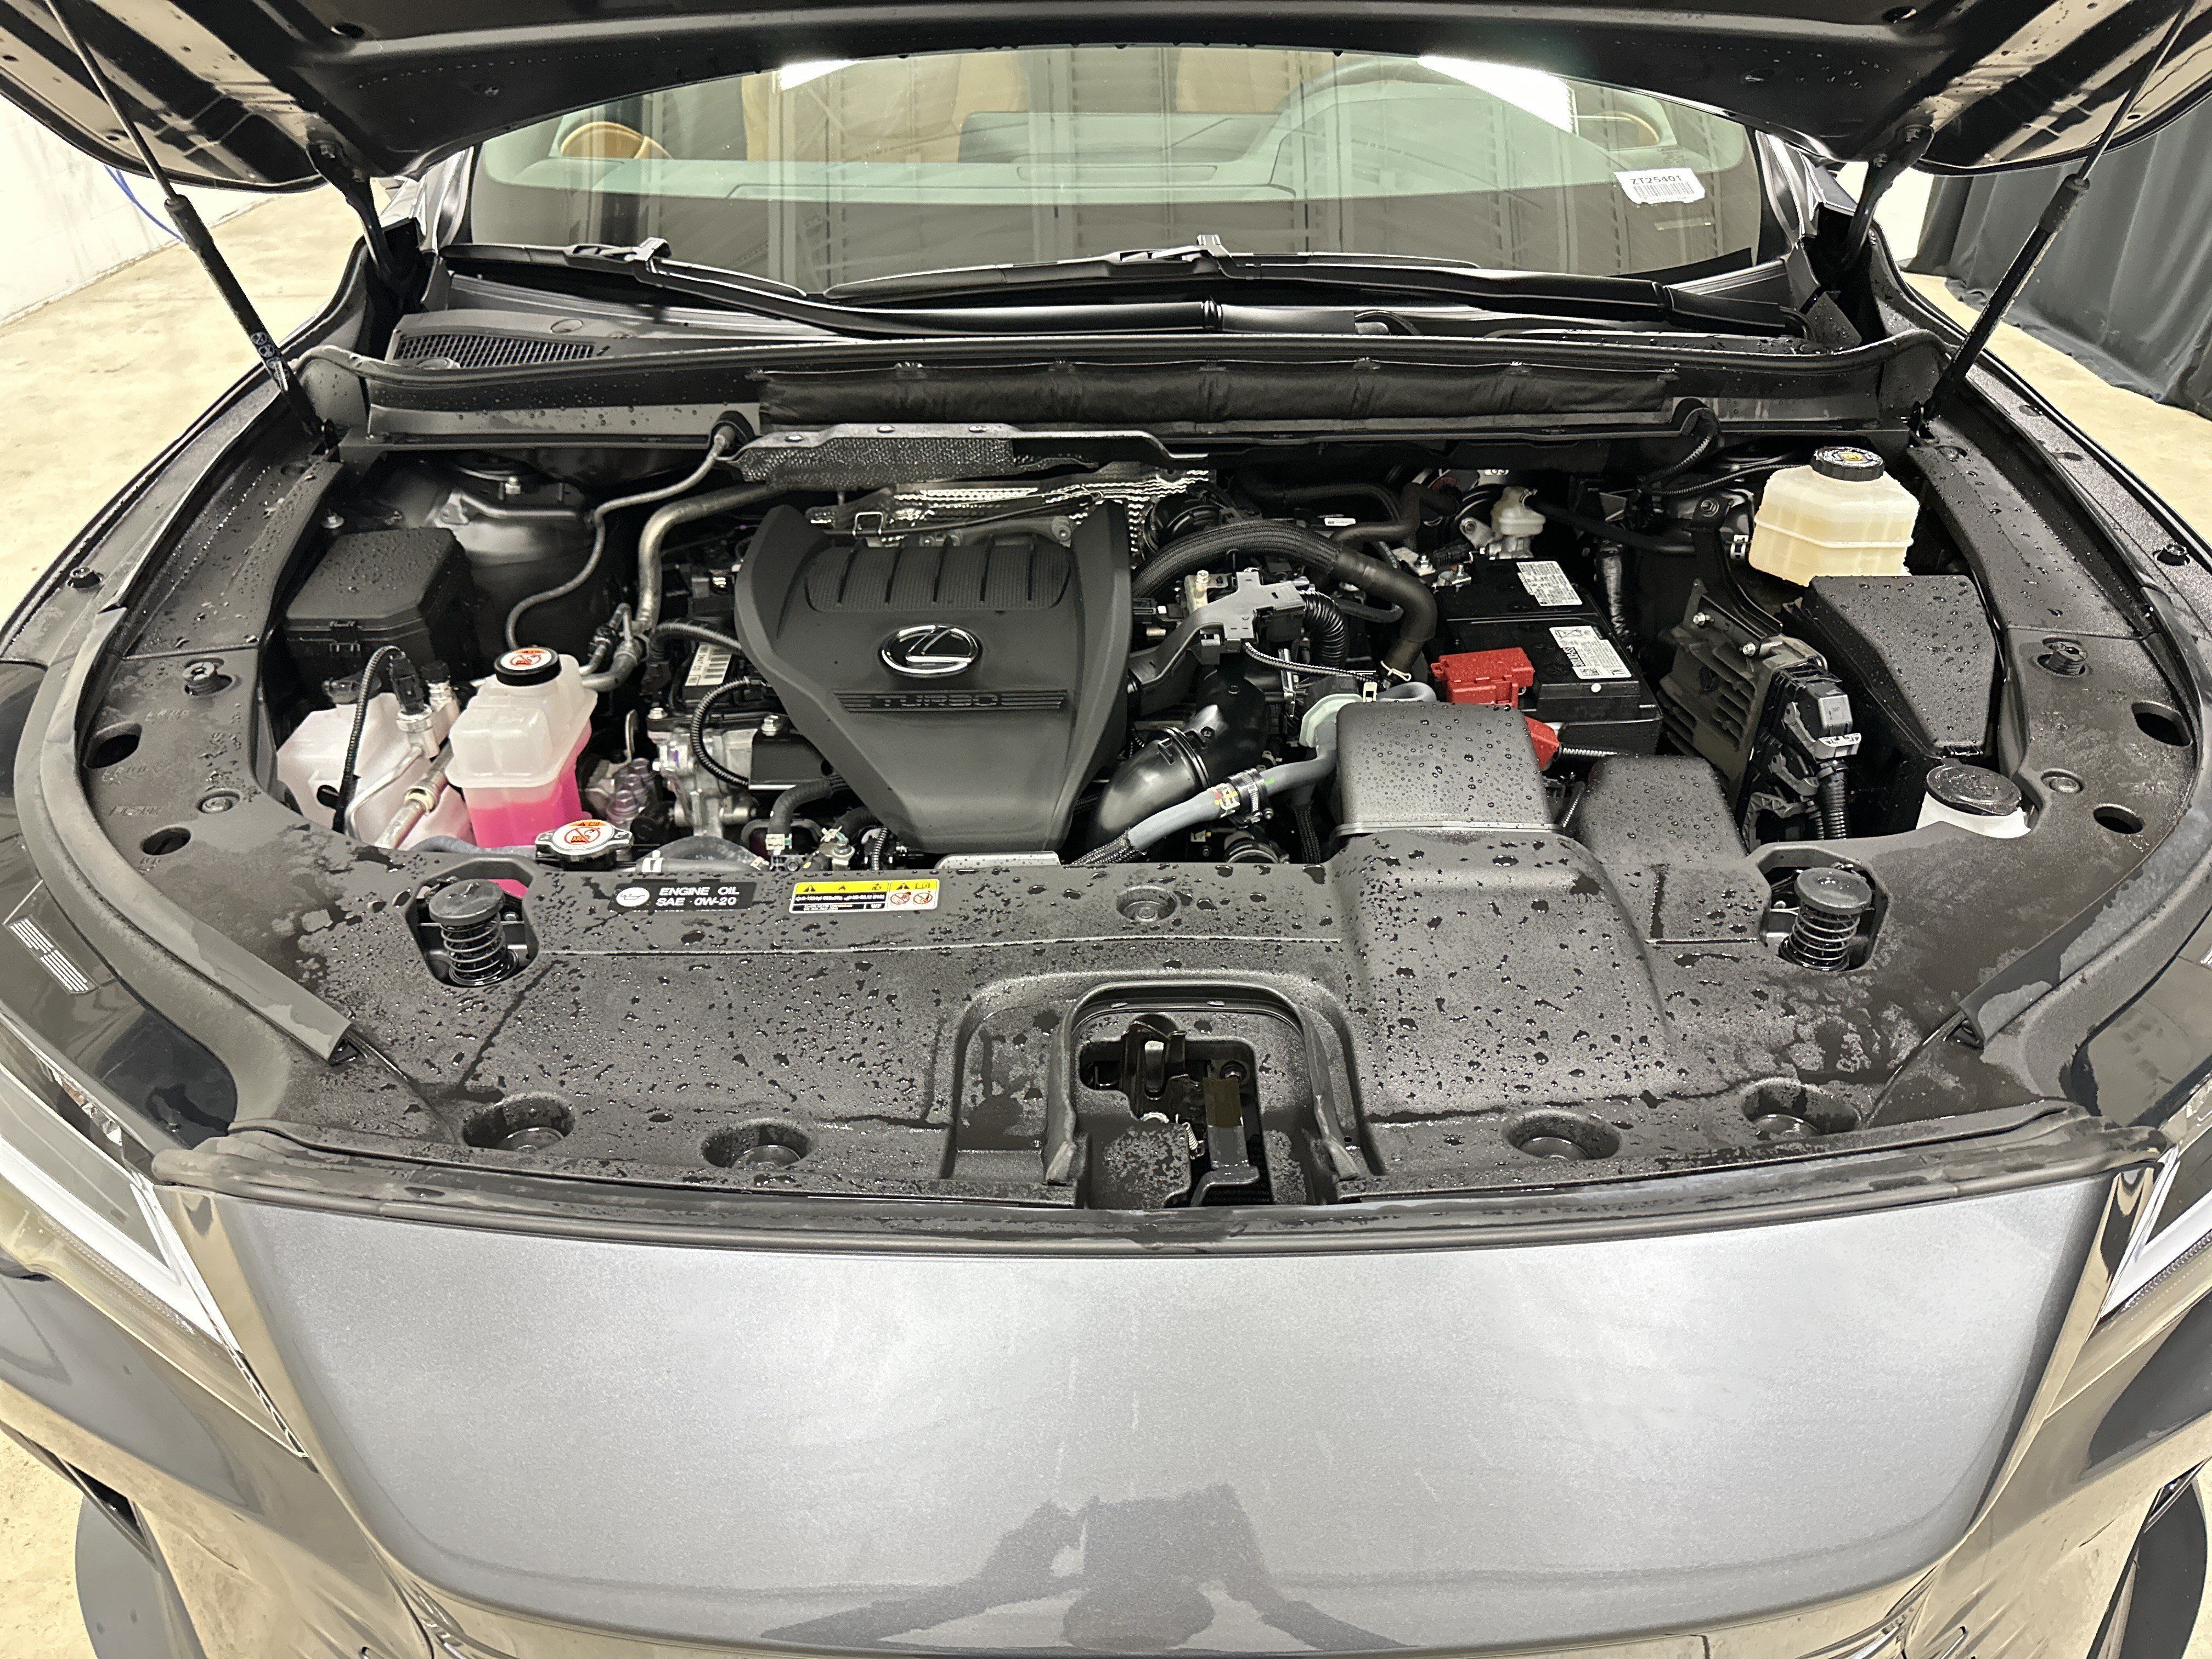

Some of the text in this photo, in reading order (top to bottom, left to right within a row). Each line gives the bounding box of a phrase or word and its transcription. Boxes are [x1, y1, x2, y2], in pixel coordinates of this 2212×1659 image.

[1630, 175, 1682, 185] ZT25401
[874, 694, 998, 707] TURBO
[659, 886, 740, 896] ENGINE OIL
[656, 896, 737, 906] SAE 0W-20
